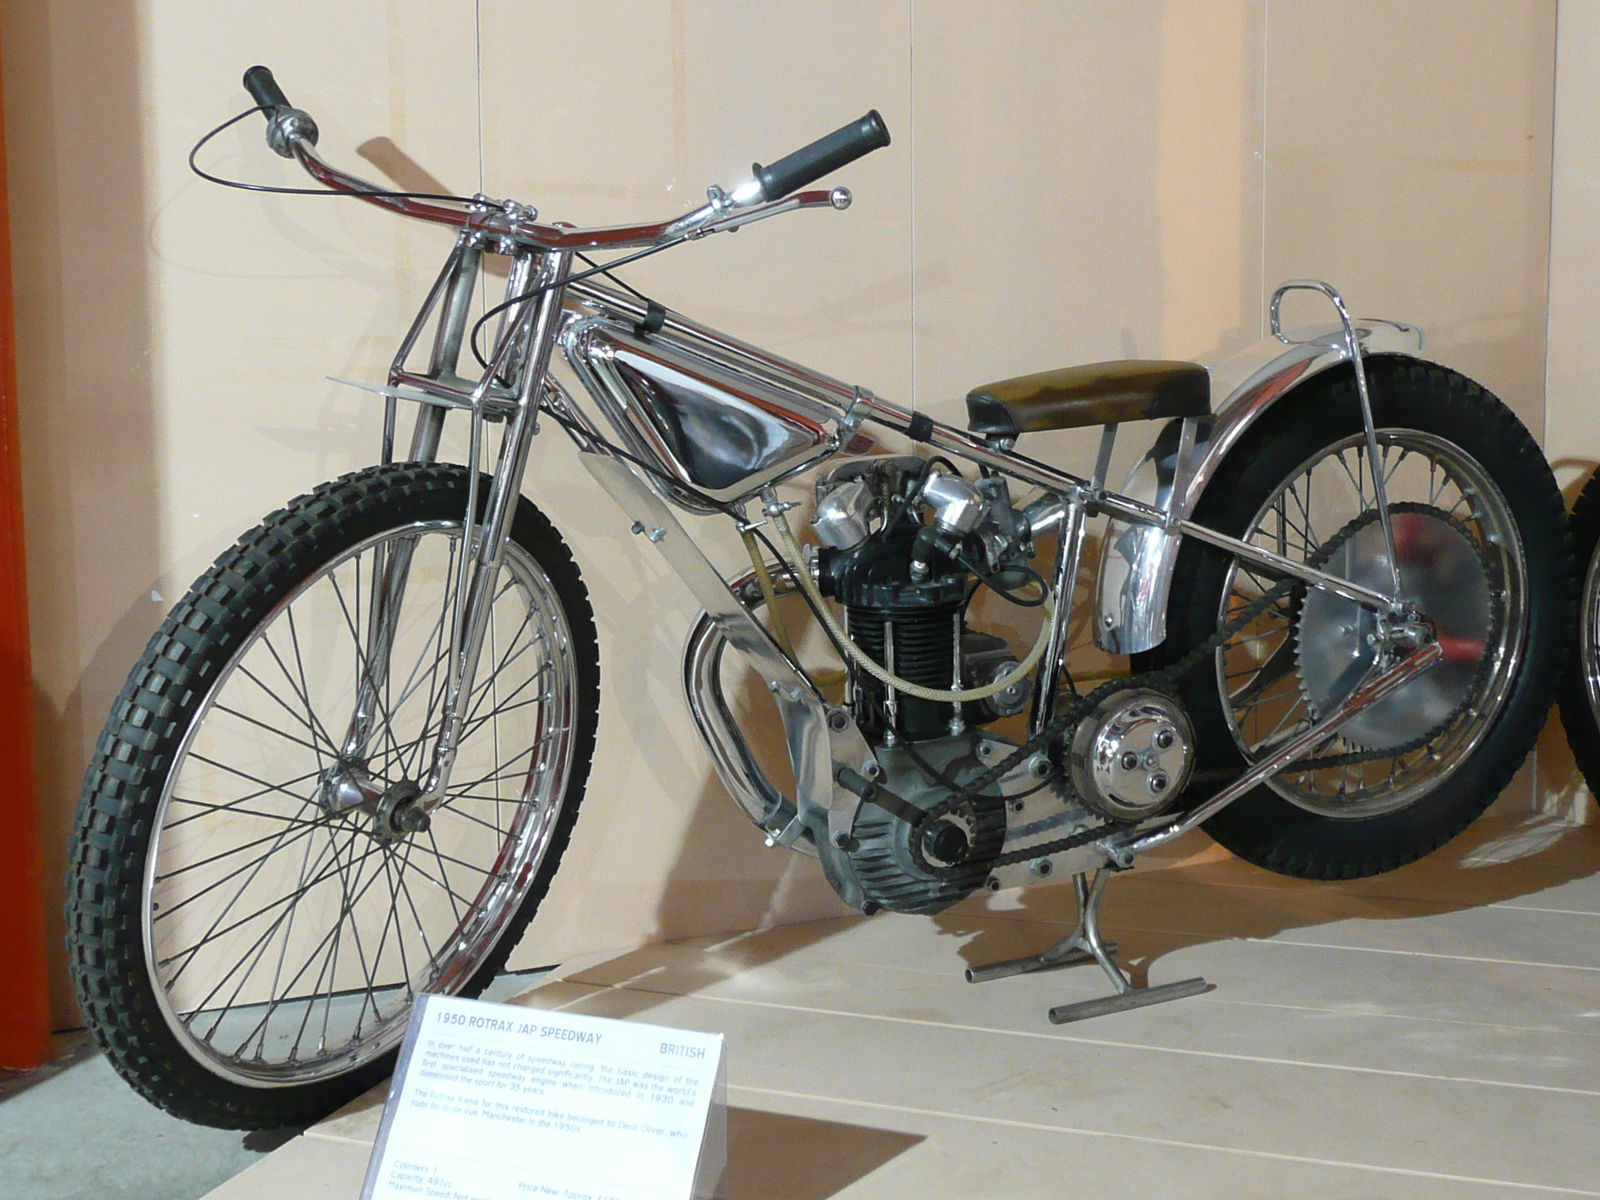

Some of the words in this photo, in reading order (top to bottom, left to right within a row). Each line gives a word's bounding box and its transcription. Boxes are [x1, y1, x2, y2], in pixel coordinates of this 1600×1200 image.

[437, 1012, 466, 1025] 1950
[468, 1016, 514, 1032] ROTRAX
[516, 1023, 537, 1035] JAP
[540, 1026, 602, 1045] SPEEDWAY
[438, 1042, 455, 1050] over
[484, 1048, 512, 1060] century
[516, 1053, 525, 1061] of
[528, 1055, 566, 1068] speedway
[600, 1065, 613, 1074] the
[617, 1067, 639, 1078] basic
[642, 1071, 670, 1082] design
[673, 1075, 683, 1084] of
[685, 1077, 699, 1086] the
[660, 1042, 706, 1059] BRITISH
[419, 1069, 459, 1082] dominated
[461, 1074, 473, 1083] the
[475, 1078, 495, 1089] sport
[496, 1080, 507, 1089] for
[510, 1082, 521, 1091] 35
[422, 1058, 437, 1068] first
[441, 1063, 484, 1075] specialised
[488, 1069, 526, 1082] speedway
[531, 1077, 557, 1087] engine
[562, 1081, 583, 1091] when
[588, 1085, 632, 1098] introduced
[651, 1093, 674, 1104] 1930
[679, 1098, 695, 1108] and
[424, 1050, 459, 1062] machines
[462, 1056, 480, 1065] used
[482, 1058, 495, 1067] has
[498, 1061, 511, 1069] not
[512, 1061, 546, 1075] changed
[598, 1074, 612, 1084] The
[615, 1077, 631, 1086] JAP
[632, 1081, 648, 1090] was
[651, 1082, 665, 1092] the
[410, 1099, 428, 1109] rode
[430, 1101, 441, 1110] for
[482, 1110, 526, 1124] Manchester
[529, 1118, 536, 1127] in
[538, 1119, 551, 1128] the
[415, 1088, 428, 1098] The
[481, 1098, 492, 1108] for
[495, 1101, 509, 1111] this
[512, 1104, 545, 1117] restored
[547, 1110, 564, 1120] bike
[567, 1112, 604, 1126] belonged
[607, 1119, 616, 1128] to
[388, 1180, 424, 1194] Maximum
[427, 1176, 453, 1189] 497cc
[518, 1181, 538, 1192] Price
